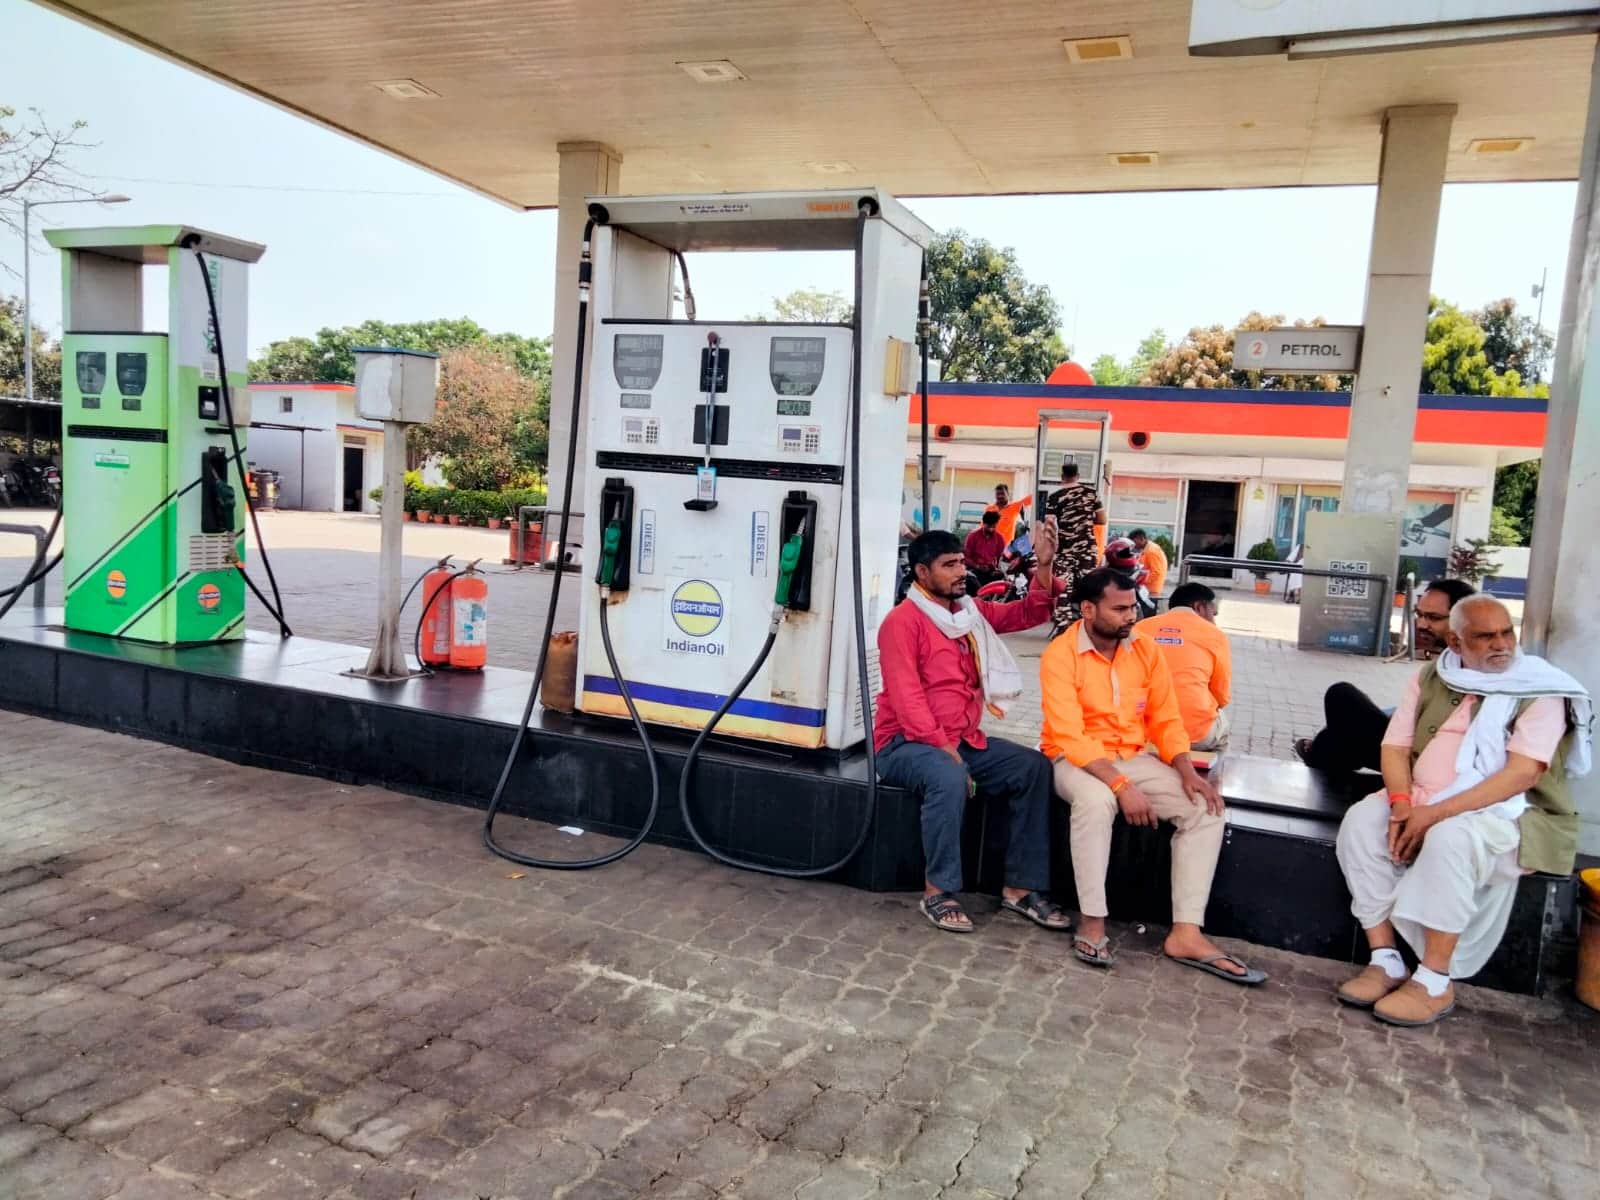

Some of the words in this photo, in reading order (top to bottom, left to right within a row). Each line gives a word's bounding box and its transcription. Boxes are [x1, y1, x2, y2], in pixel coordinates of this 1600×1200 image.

[1252, 342, 1263, 356] 2
[1281, 344, 1342, 357] PETROL
[643, 523, 653, 560] DIESEL
[755, 525, 766, 564] DIESEL
[666, 638, 725, 656] IndianOil
